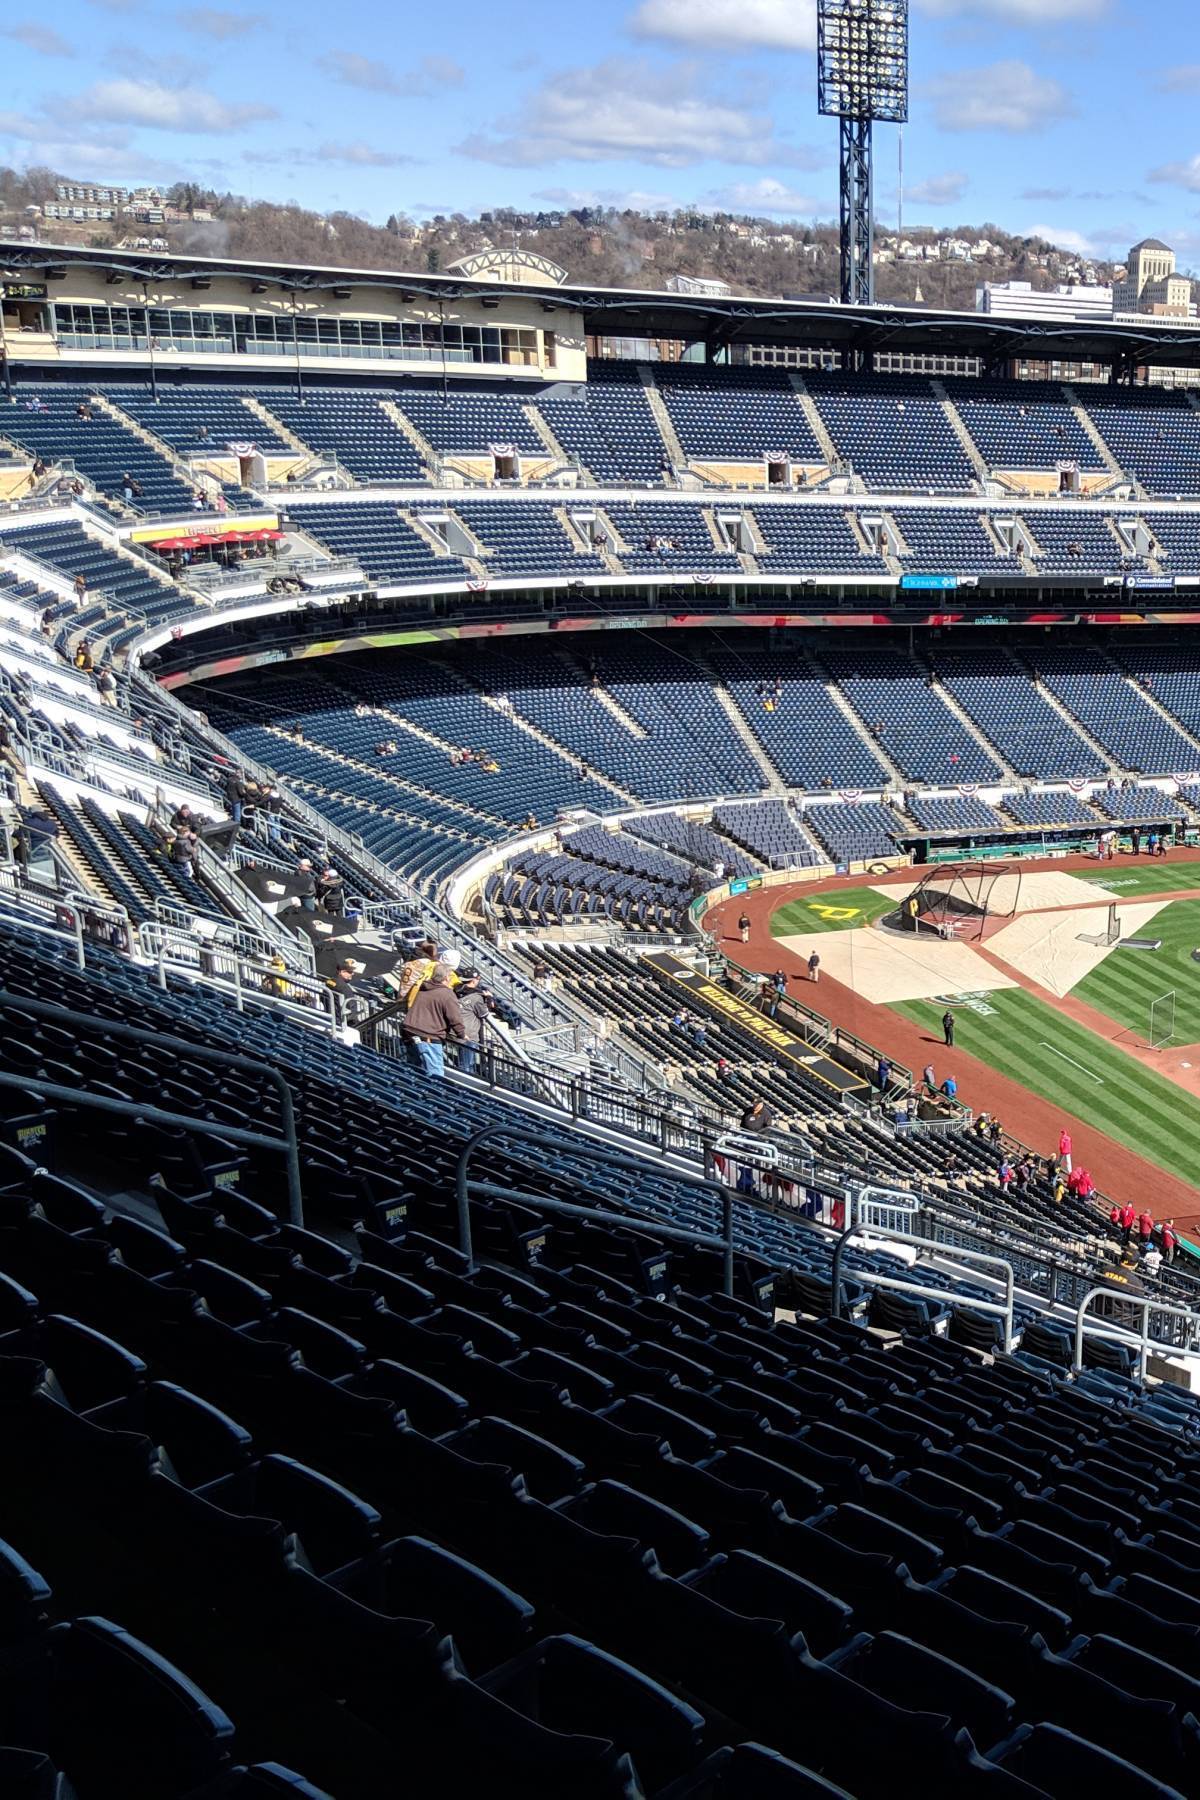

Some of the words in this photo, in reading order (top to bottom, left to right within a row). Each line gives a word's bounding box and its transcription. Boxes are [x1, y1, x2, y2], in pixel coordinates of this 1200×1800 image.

[697, 985, 746, 1013] WELCOME
[743, 1017, 773, 1031] PNC
[762, 1028, 797, 1047] PARK
